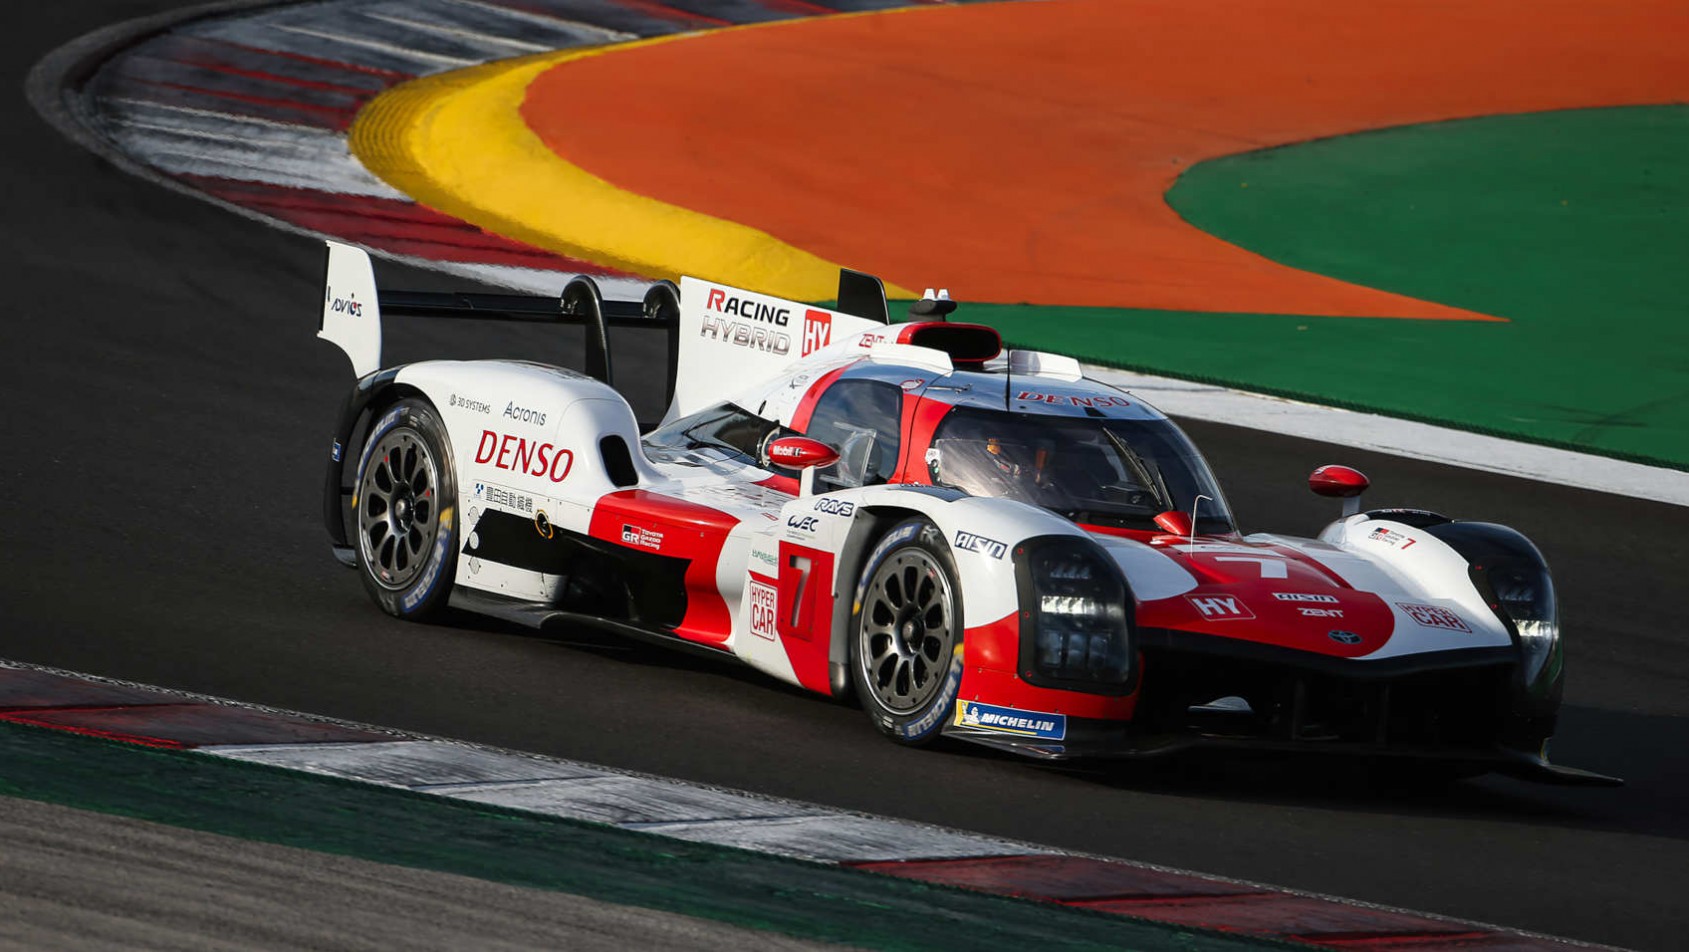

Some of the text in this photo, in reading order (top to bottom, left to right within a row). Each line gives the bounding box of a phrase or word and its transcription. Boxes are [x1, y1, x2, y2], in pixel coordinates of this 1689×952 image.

[707, 287, 791, 327] RACING
[700, 315, 792, 356] HYBRID
[803, 318, 831, 354] HY
[465, 399, 491, 414] SYSTEMS
[1017, 391, 1131, 408] DENSO
[503, 400, 547, 426] Acronis
[474, 429, 574, 483] DENSO
[814, 497, 854, 517] RAYS
[787, 514, 819, 532] WEC
[954, 531, 1007, 559] AISIN
[1401, 537, 1417, 550] 7
[1214, 556, 1289, 579] 7
[751, 585, 776, 611] HYPER
[789, 554, 812, 629] 7
[1192, 597, 1242, 616] HY
[1297, 607, 1345, 618] ZENT
[752, 603, 775, 636] CAR
[1411, 611, 1467, 630] CAR
[981, 712, 1055, 732] MICHELIN
